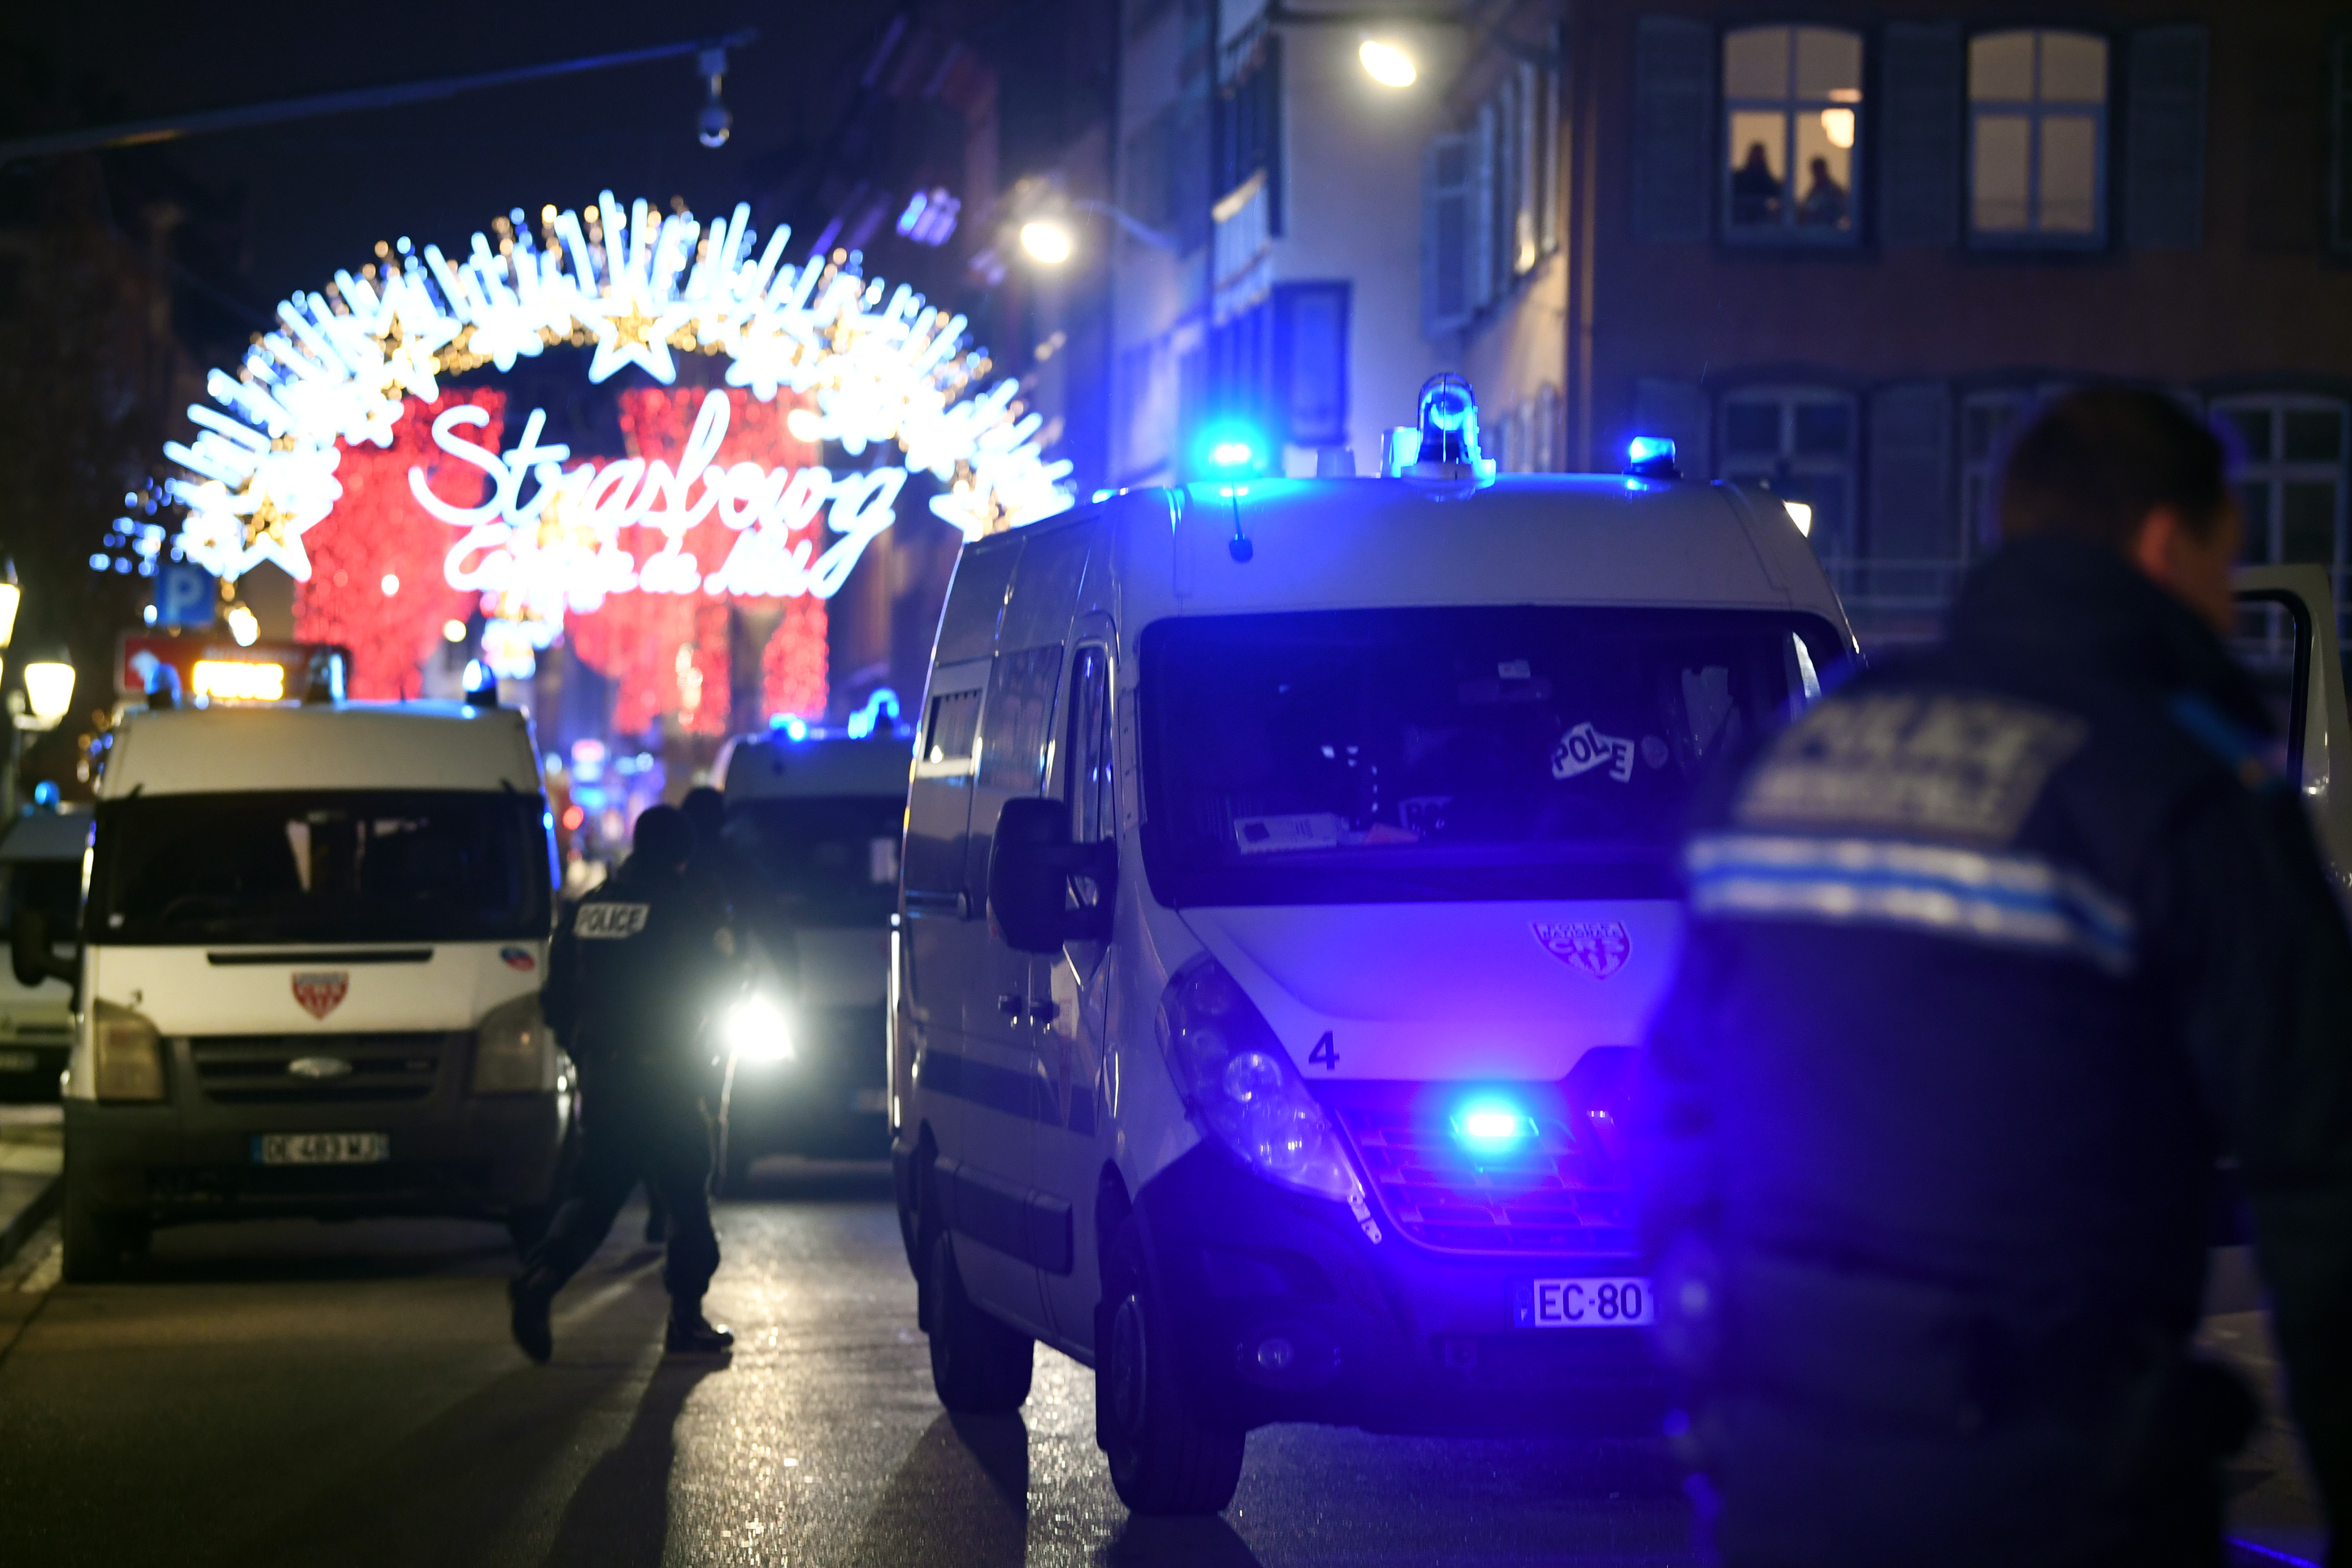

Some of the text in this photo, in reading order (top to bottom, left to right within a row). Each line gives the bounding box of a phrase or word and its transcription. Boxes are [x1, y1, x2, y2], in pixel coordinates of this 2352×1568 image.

[408, 389, 907, 598] Strasbourg
[166, 567, 204, 625] P
[579, 907, 642, 931] POLICE
[1548, 939, 1625, 954] CRS
[1308, 1031, 1340, 1070] 4
[1539, 1282, 1653, 1320] EC-80
